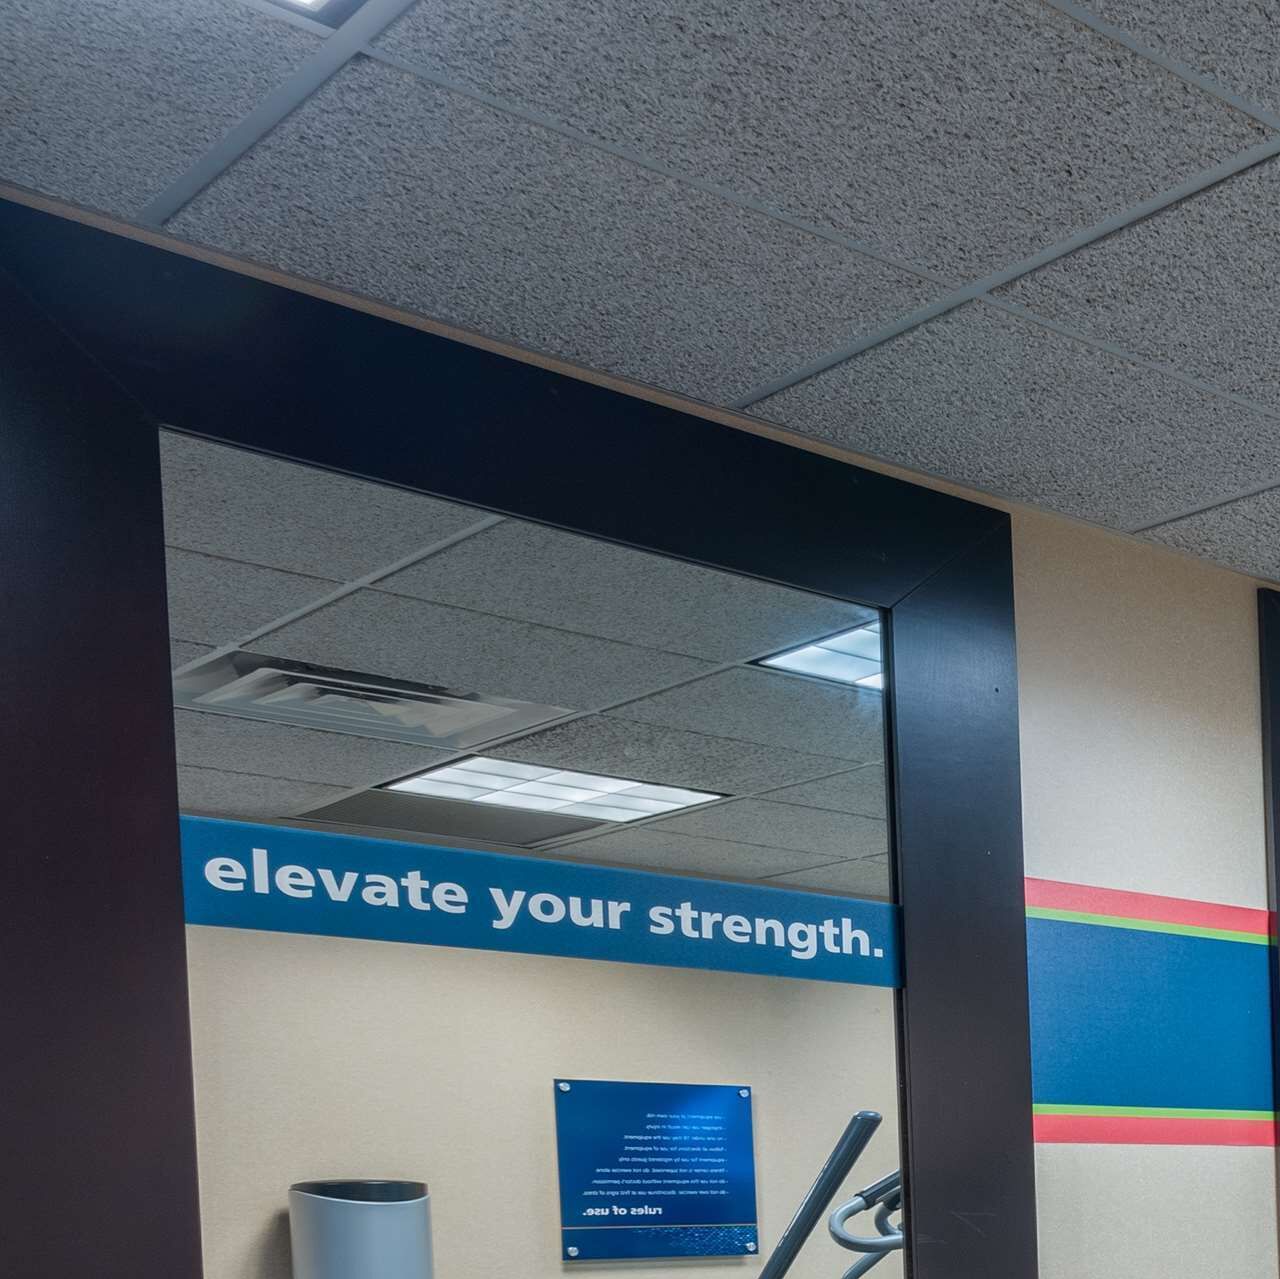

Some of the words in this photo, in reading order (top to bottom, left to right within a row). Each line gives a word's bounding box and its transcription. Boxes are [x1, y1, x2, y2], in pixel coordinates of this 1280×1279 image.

[204, 848, 468, 914] elevate
[489, 887, 631, 930] your
[649, 902, 883, 960] strength.
